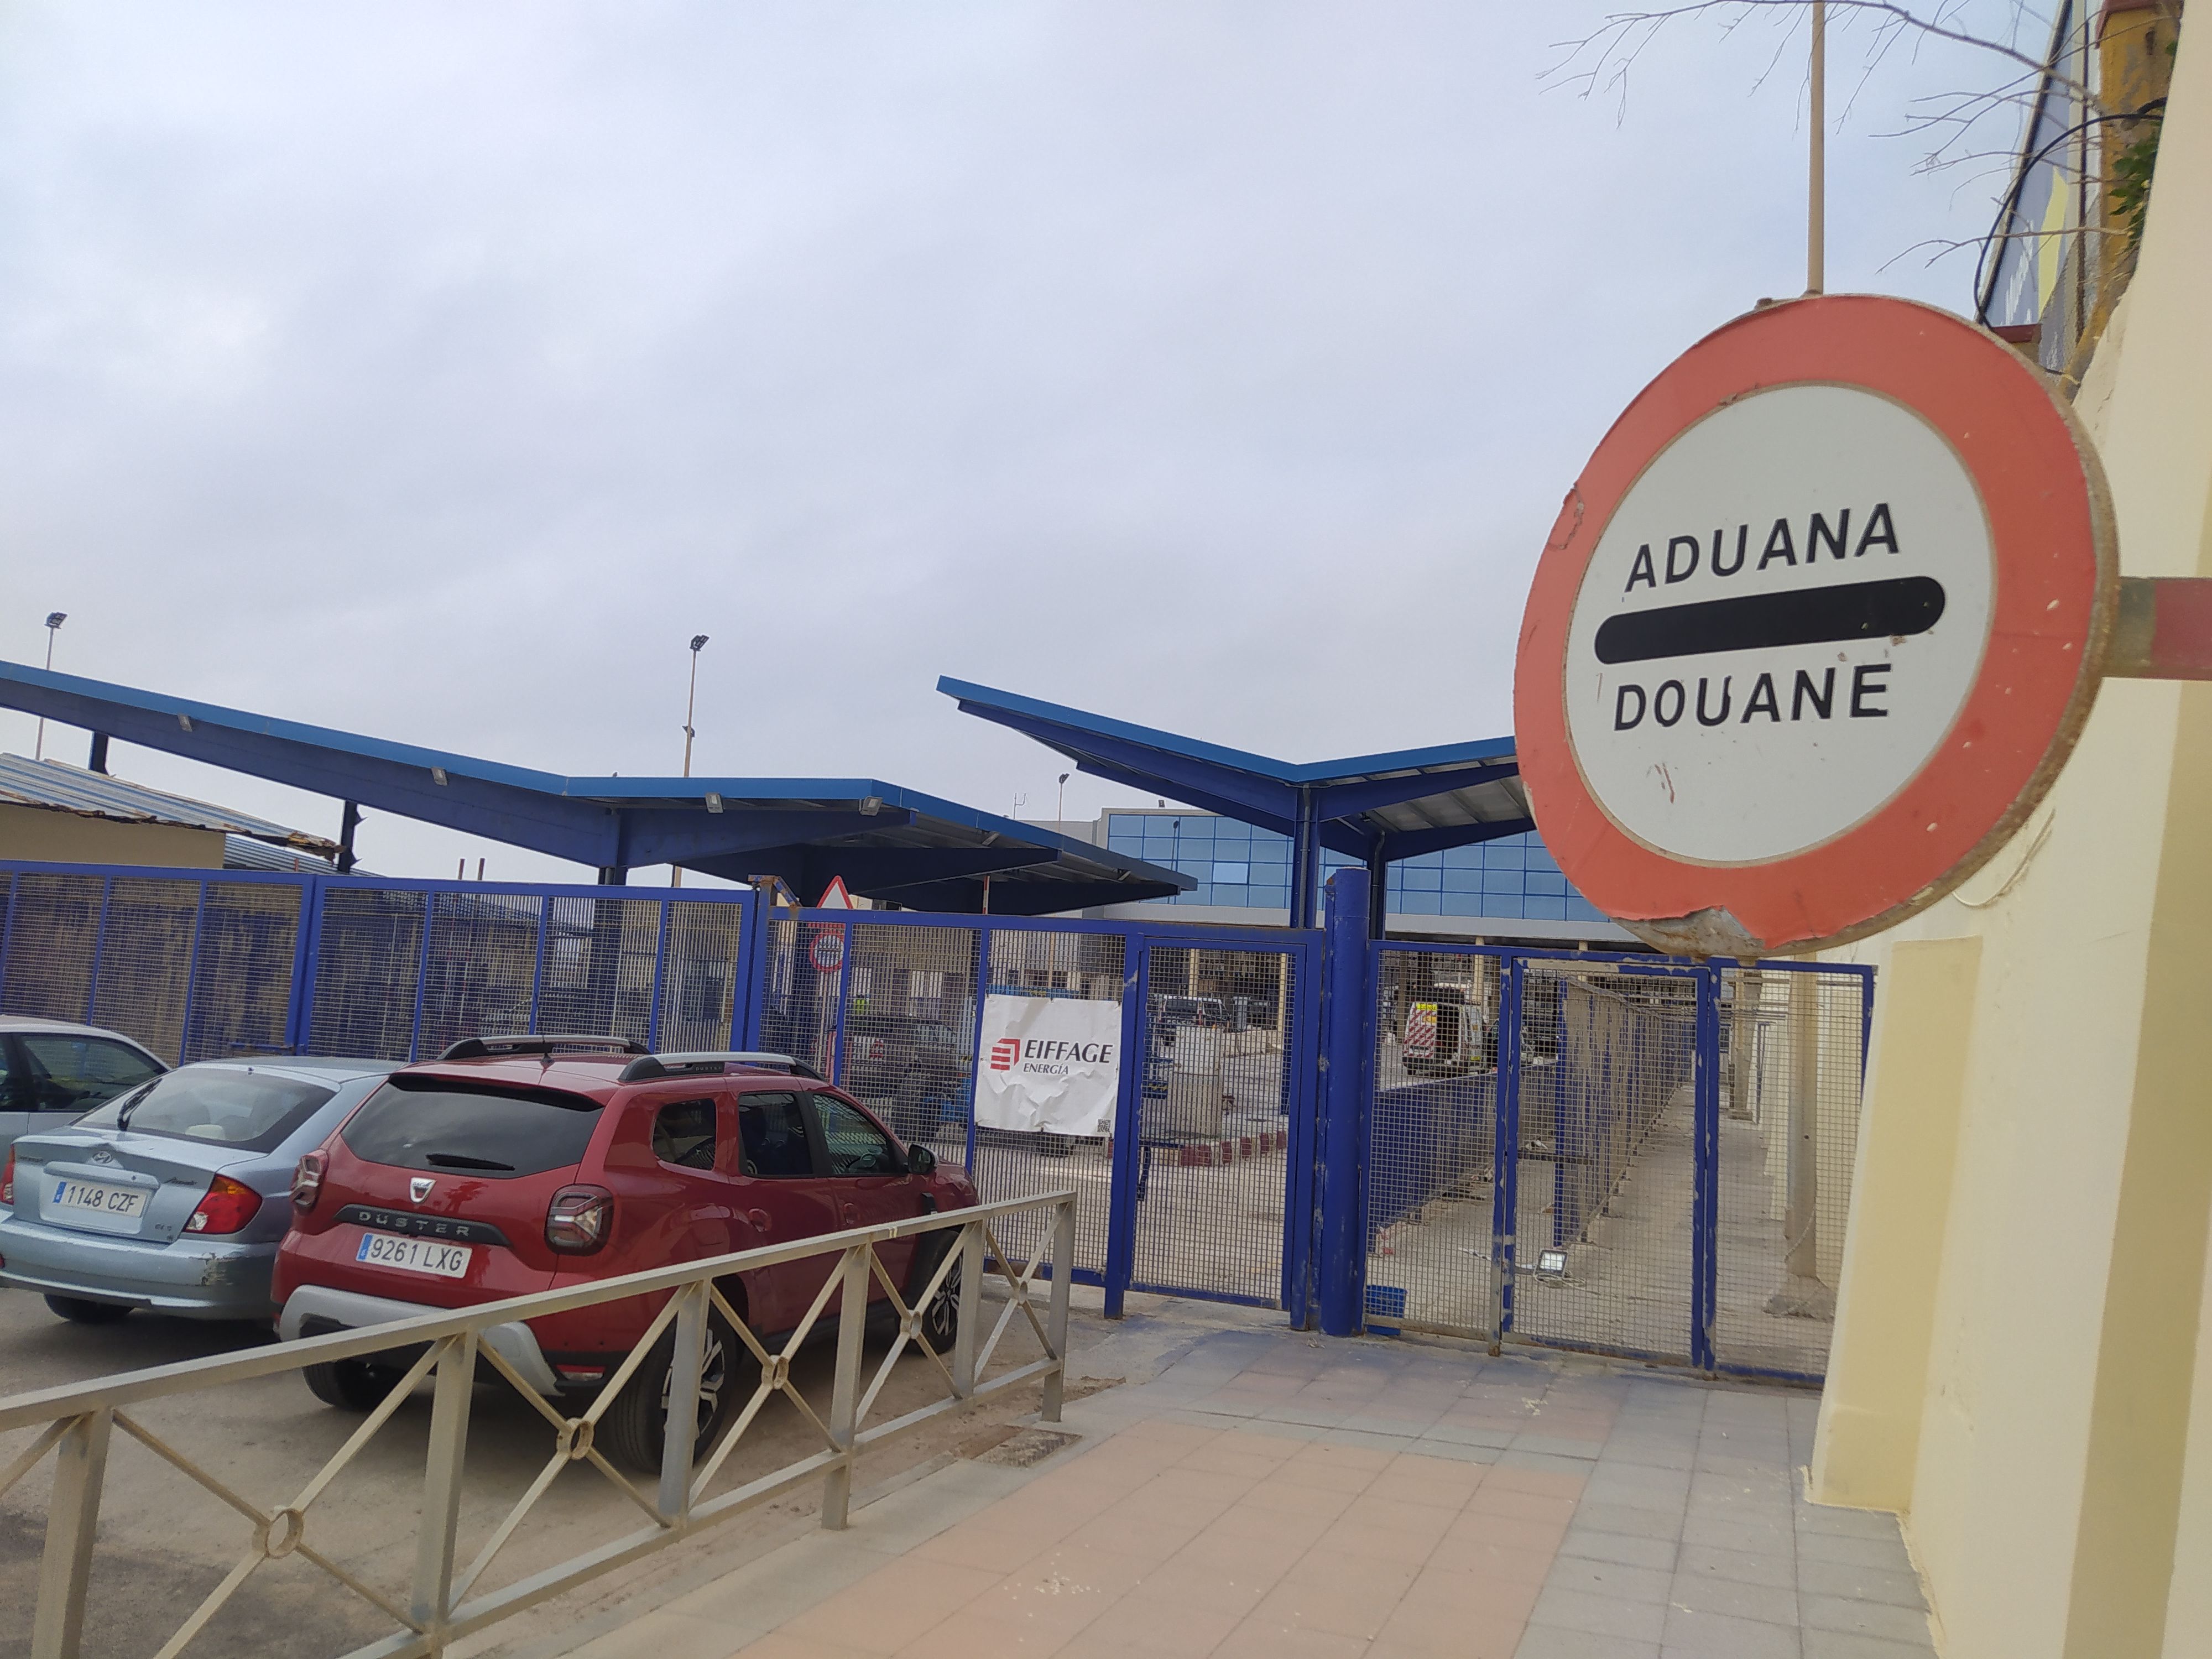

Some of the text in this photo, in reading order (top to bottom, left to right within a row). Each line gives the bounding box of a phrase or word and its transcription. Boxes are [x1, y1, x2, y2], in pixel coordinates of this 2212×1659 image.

[1624, 503, 1900, 593] ADUANA
[1614, 664, 1892, 731] DOUANE
[1024, 1040, 1113, 1063] EIFFAGE
[1023, 1063, 1068, 1074] ENERGÍA
[67, 1186, 138, 1212] 1148 CZF
[359, 1212, 470, 1237] DUSTER
[371, 1239, 463, 1271] 9261 LXG
